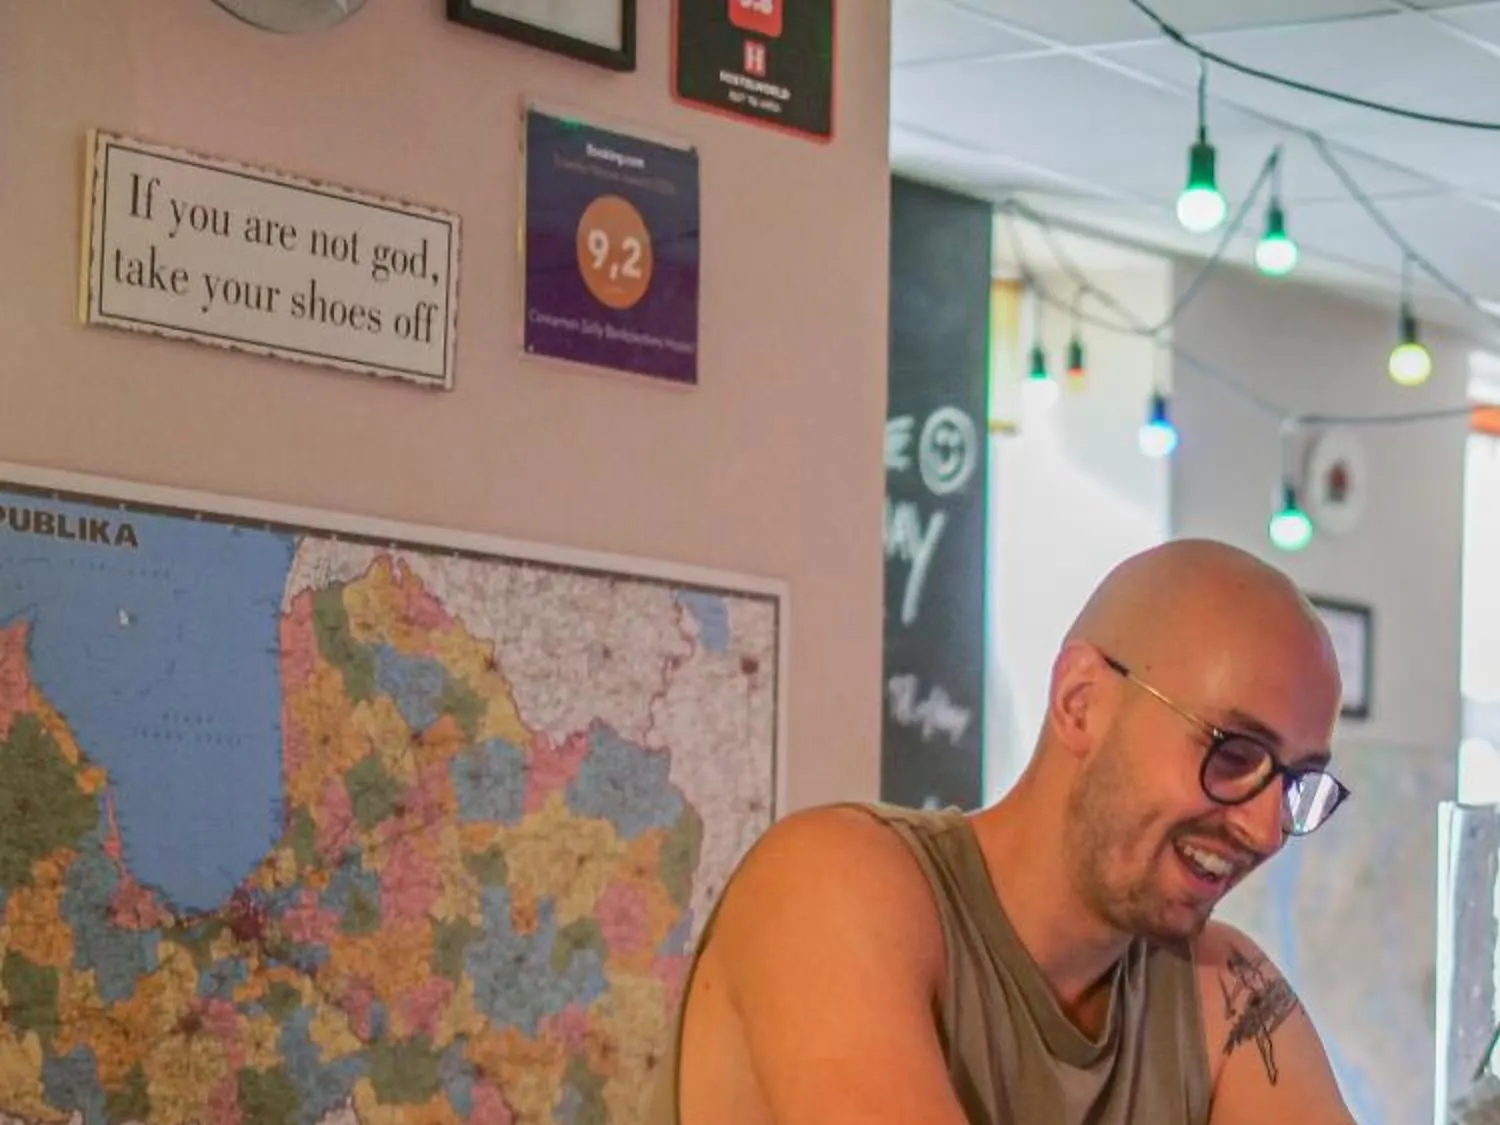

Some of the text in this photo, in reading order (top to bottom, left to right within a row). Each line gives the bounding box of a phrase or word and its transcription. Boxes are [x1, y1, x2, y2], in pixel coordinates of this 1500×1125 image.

[129, 173, 440, 287] If you are not god,
[114, 246, 439, 344] take your shoes off
[0, 505, 139, 549] UBLIKA
